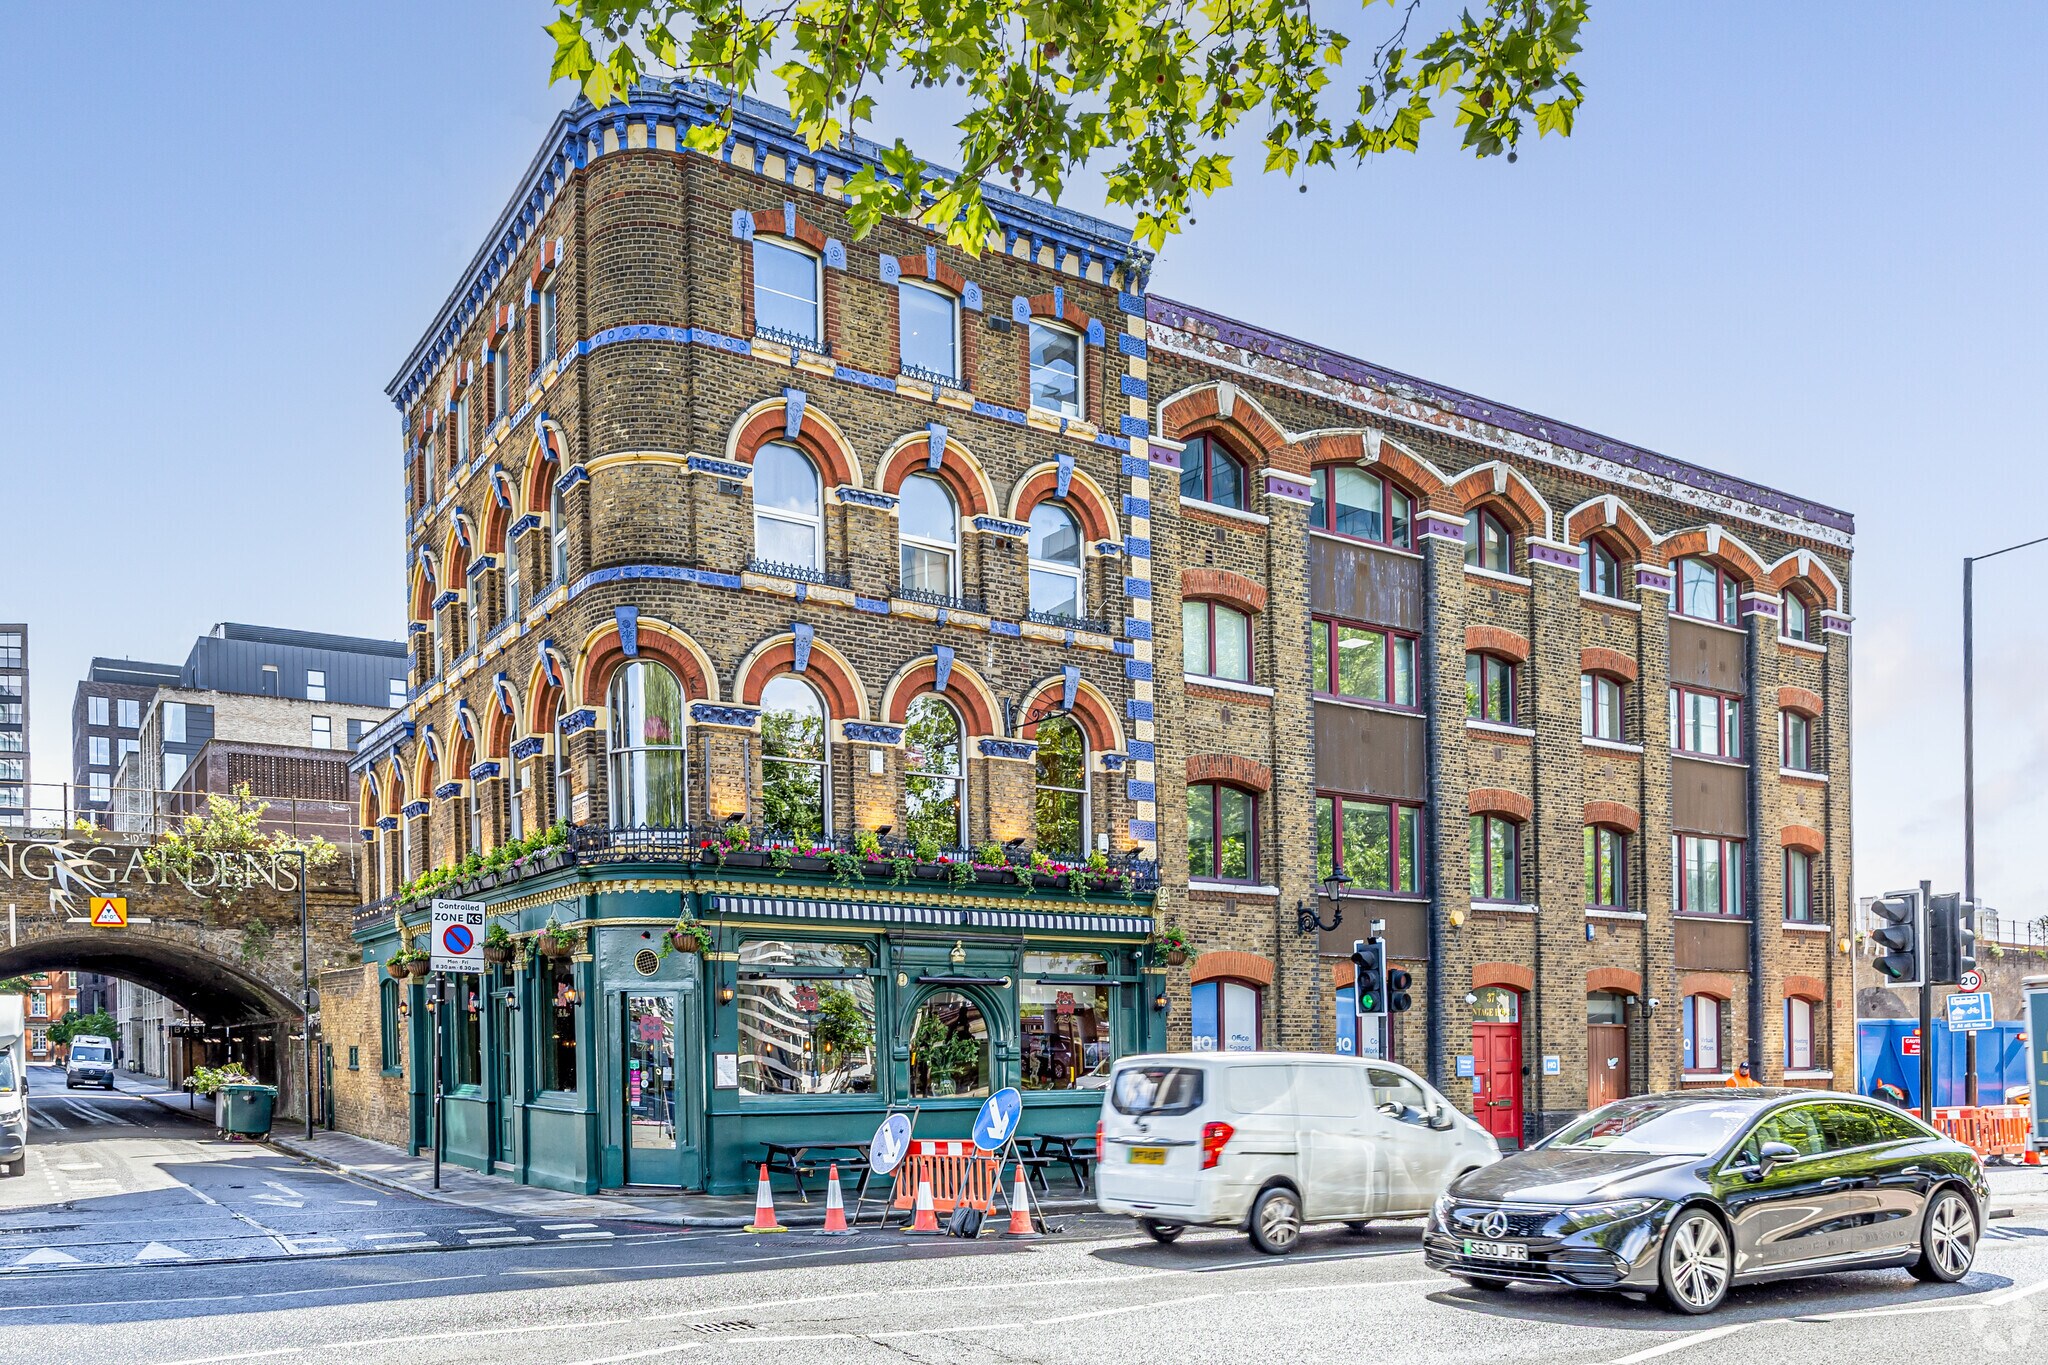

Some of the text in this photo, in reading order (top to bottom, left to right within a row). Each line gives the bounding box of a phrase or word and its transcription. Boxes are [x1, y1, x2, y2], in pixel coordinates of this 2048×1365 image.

[438, 902, 480, 911] Controlled
[434, 912, 482, 924] ZONE KS
[1961, 976, 1978, 986] 20
[1486, 992, 1495, 1003] 37
[1472, 1008, 1494, 1017] NTAGE
[1231, 1034, 1250, 1042] Office
[1502, 1245, 1527, 1259] JFR
